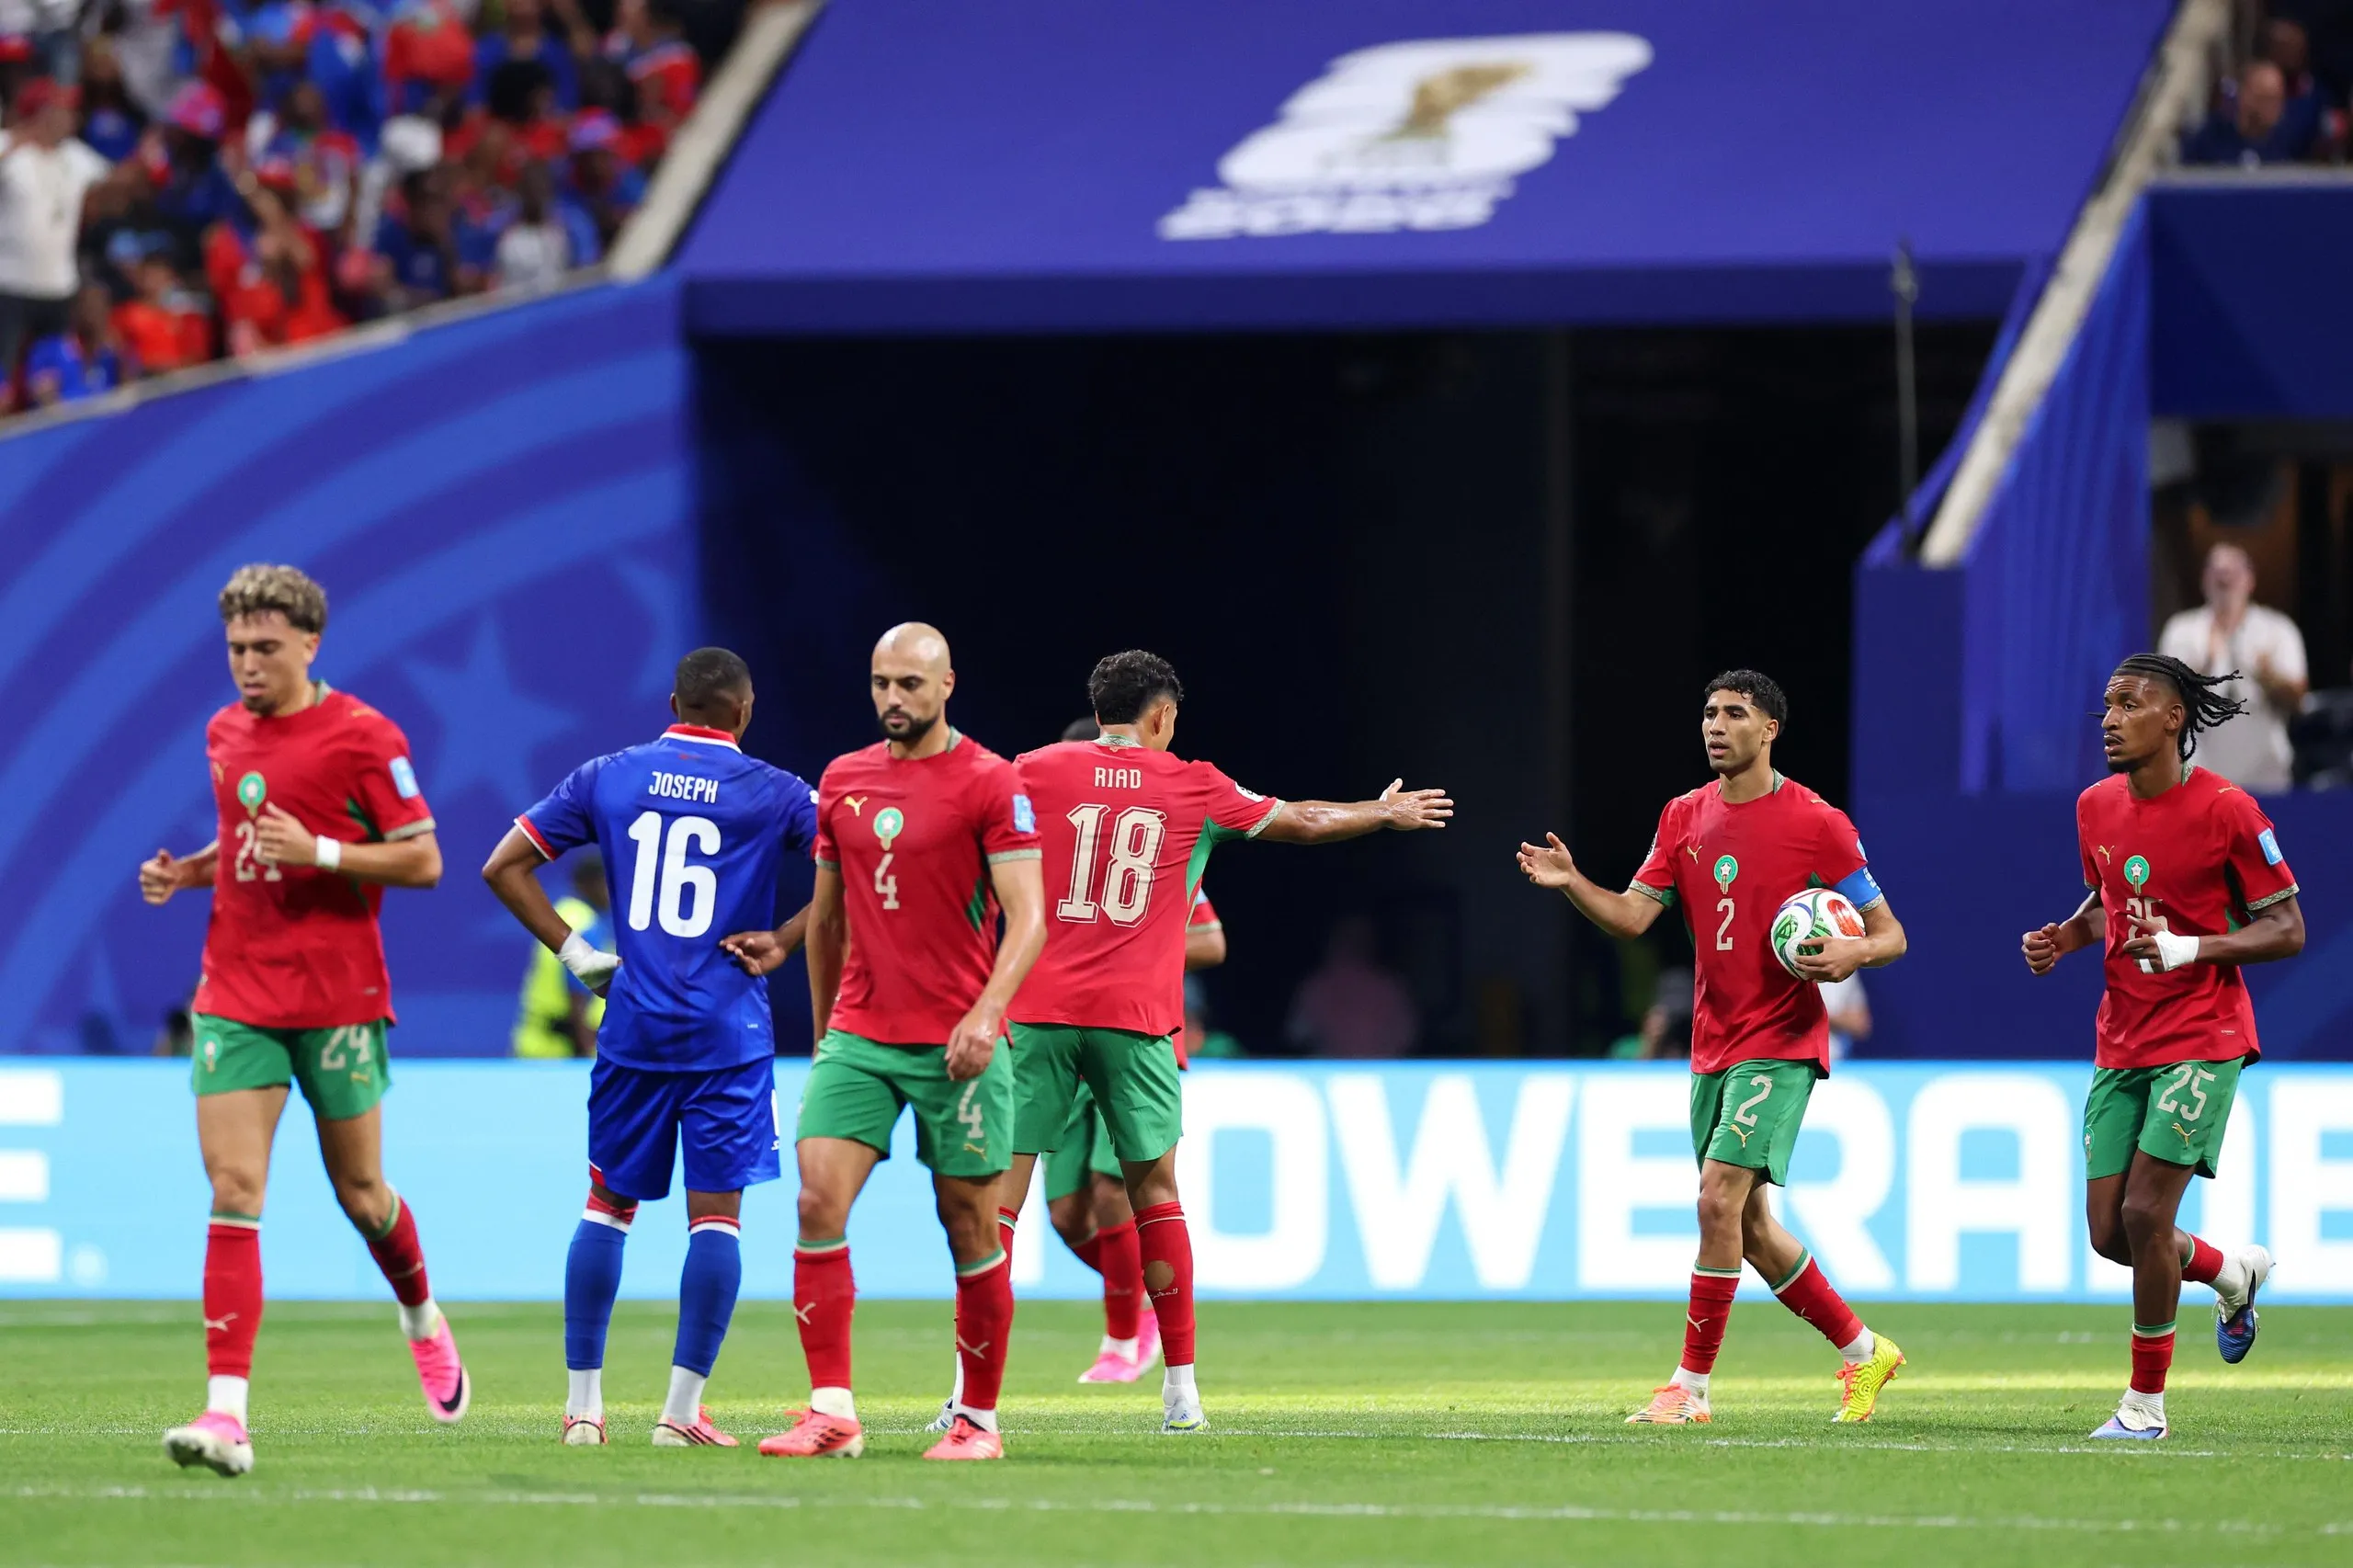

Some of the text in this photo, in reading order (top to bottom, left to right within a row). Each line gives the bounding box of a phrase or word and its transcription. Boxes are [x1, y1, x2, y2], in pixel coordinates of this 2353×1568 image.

[648, 771, 719, 803] JOSEPH
[1094, 767, 1142, 789] RIAD
[628, 811, 722, 937] 16
[874, 853, 900, 909] 4
[1057, 803, 1167, 928] 18
[1716, 898, 1734, 950] 2
[957, 1081, 984, 1139] 4
[1733, 1074, 1773, 1127] 2
[2157, 1063, 2217, 1121] 25
